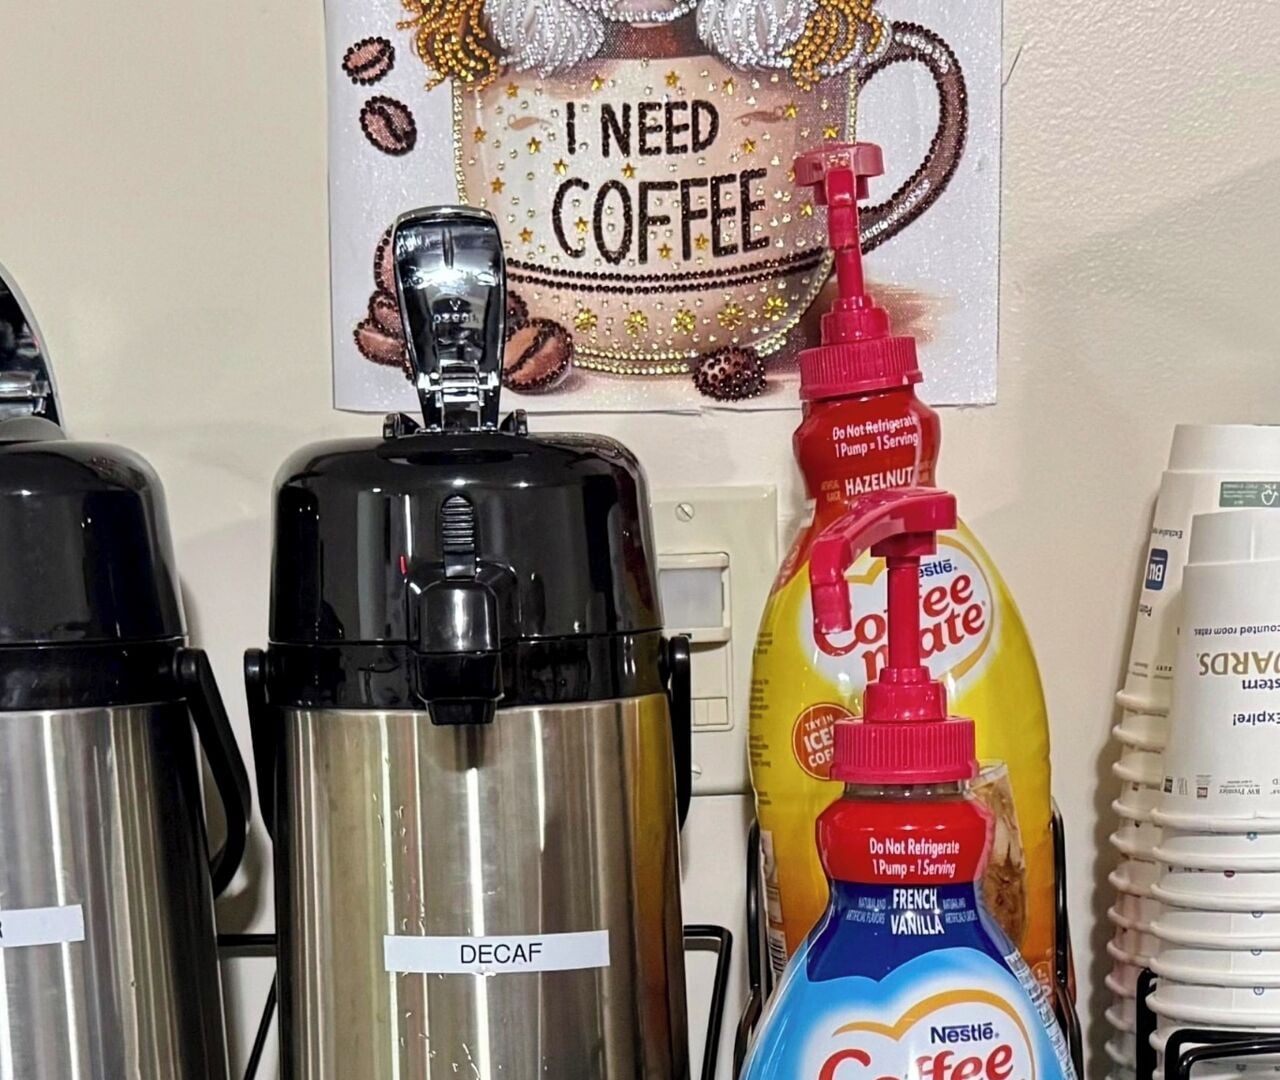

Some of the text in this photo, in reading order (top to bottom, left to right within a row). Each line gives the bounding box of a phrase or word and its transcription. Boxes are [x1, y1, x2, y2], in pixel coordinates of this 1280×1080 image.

[565, 100, 720, 157] I NEED
[552, 168, 770, 265] COFFEE
[832, 426, 845, 441] Do
[847, 423, 865, 439] Not
[841, 440, 868, 457] Pump
[883, 431, 919, 450] Serving
[844, 466, 914, 496] HAZELNUT
[1213, 626, 1238, 635] room
[804, 725, 834, 753] ICE
[869, 837, 960, 858] Do Not Refrigerate
[872, 859, 878, 875] 1
[879, 859, 907, 878] Pump
[916, 859, 922, 875] 1
[923, 859, 956, 878] Serving
[892, 888, 938, 910] FRENCH
[890, 914, 945, 935] VANILLA
[460, 942, 543, 965] DECAF
[930, 1021, 996, 1044] Nestlé
